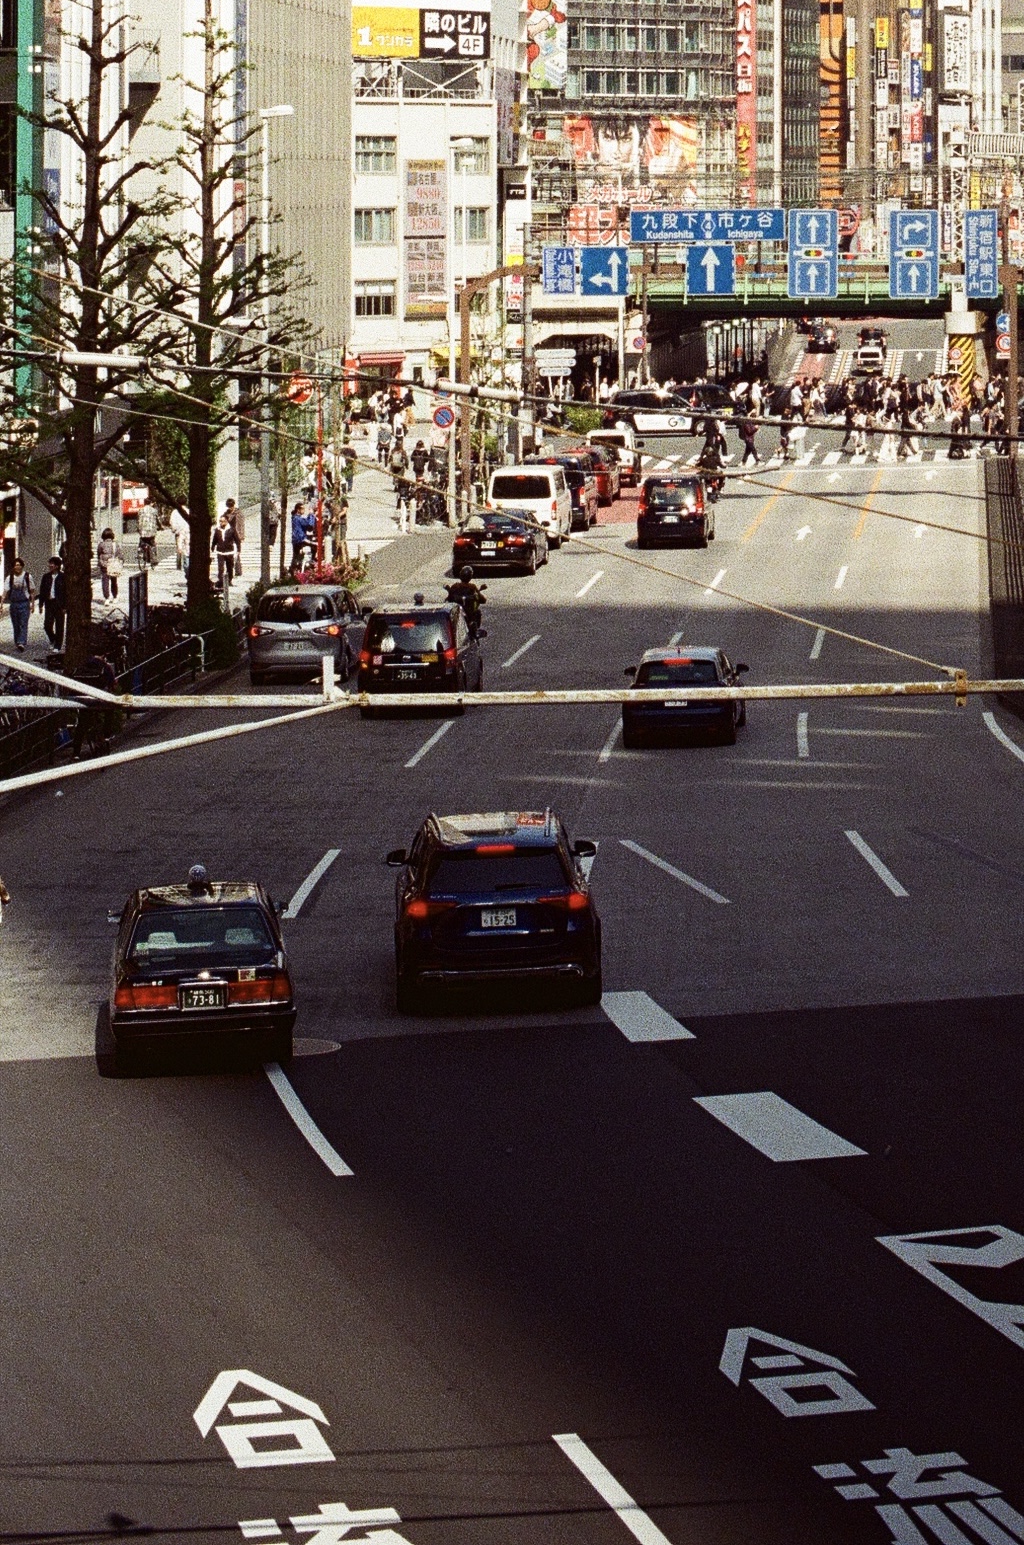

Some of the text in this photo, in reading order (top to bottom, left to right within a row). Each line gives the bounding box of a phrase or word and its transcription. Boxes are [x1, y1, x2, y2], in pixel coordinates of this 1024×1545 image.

[424, 11, 488, 34] 隣のビル
[461, 38, 481, 52] 4F
[641, 212, 699, 230] 九段下
[645, 230, 695, 240] Kudanshita
[727, 230, 764, 240] Ichigaya
[979, 214, 994, 293] 新宿駅東口
[489, 914, 515, 927] 15-25
[192, 993, 220, 1007] 73-81
